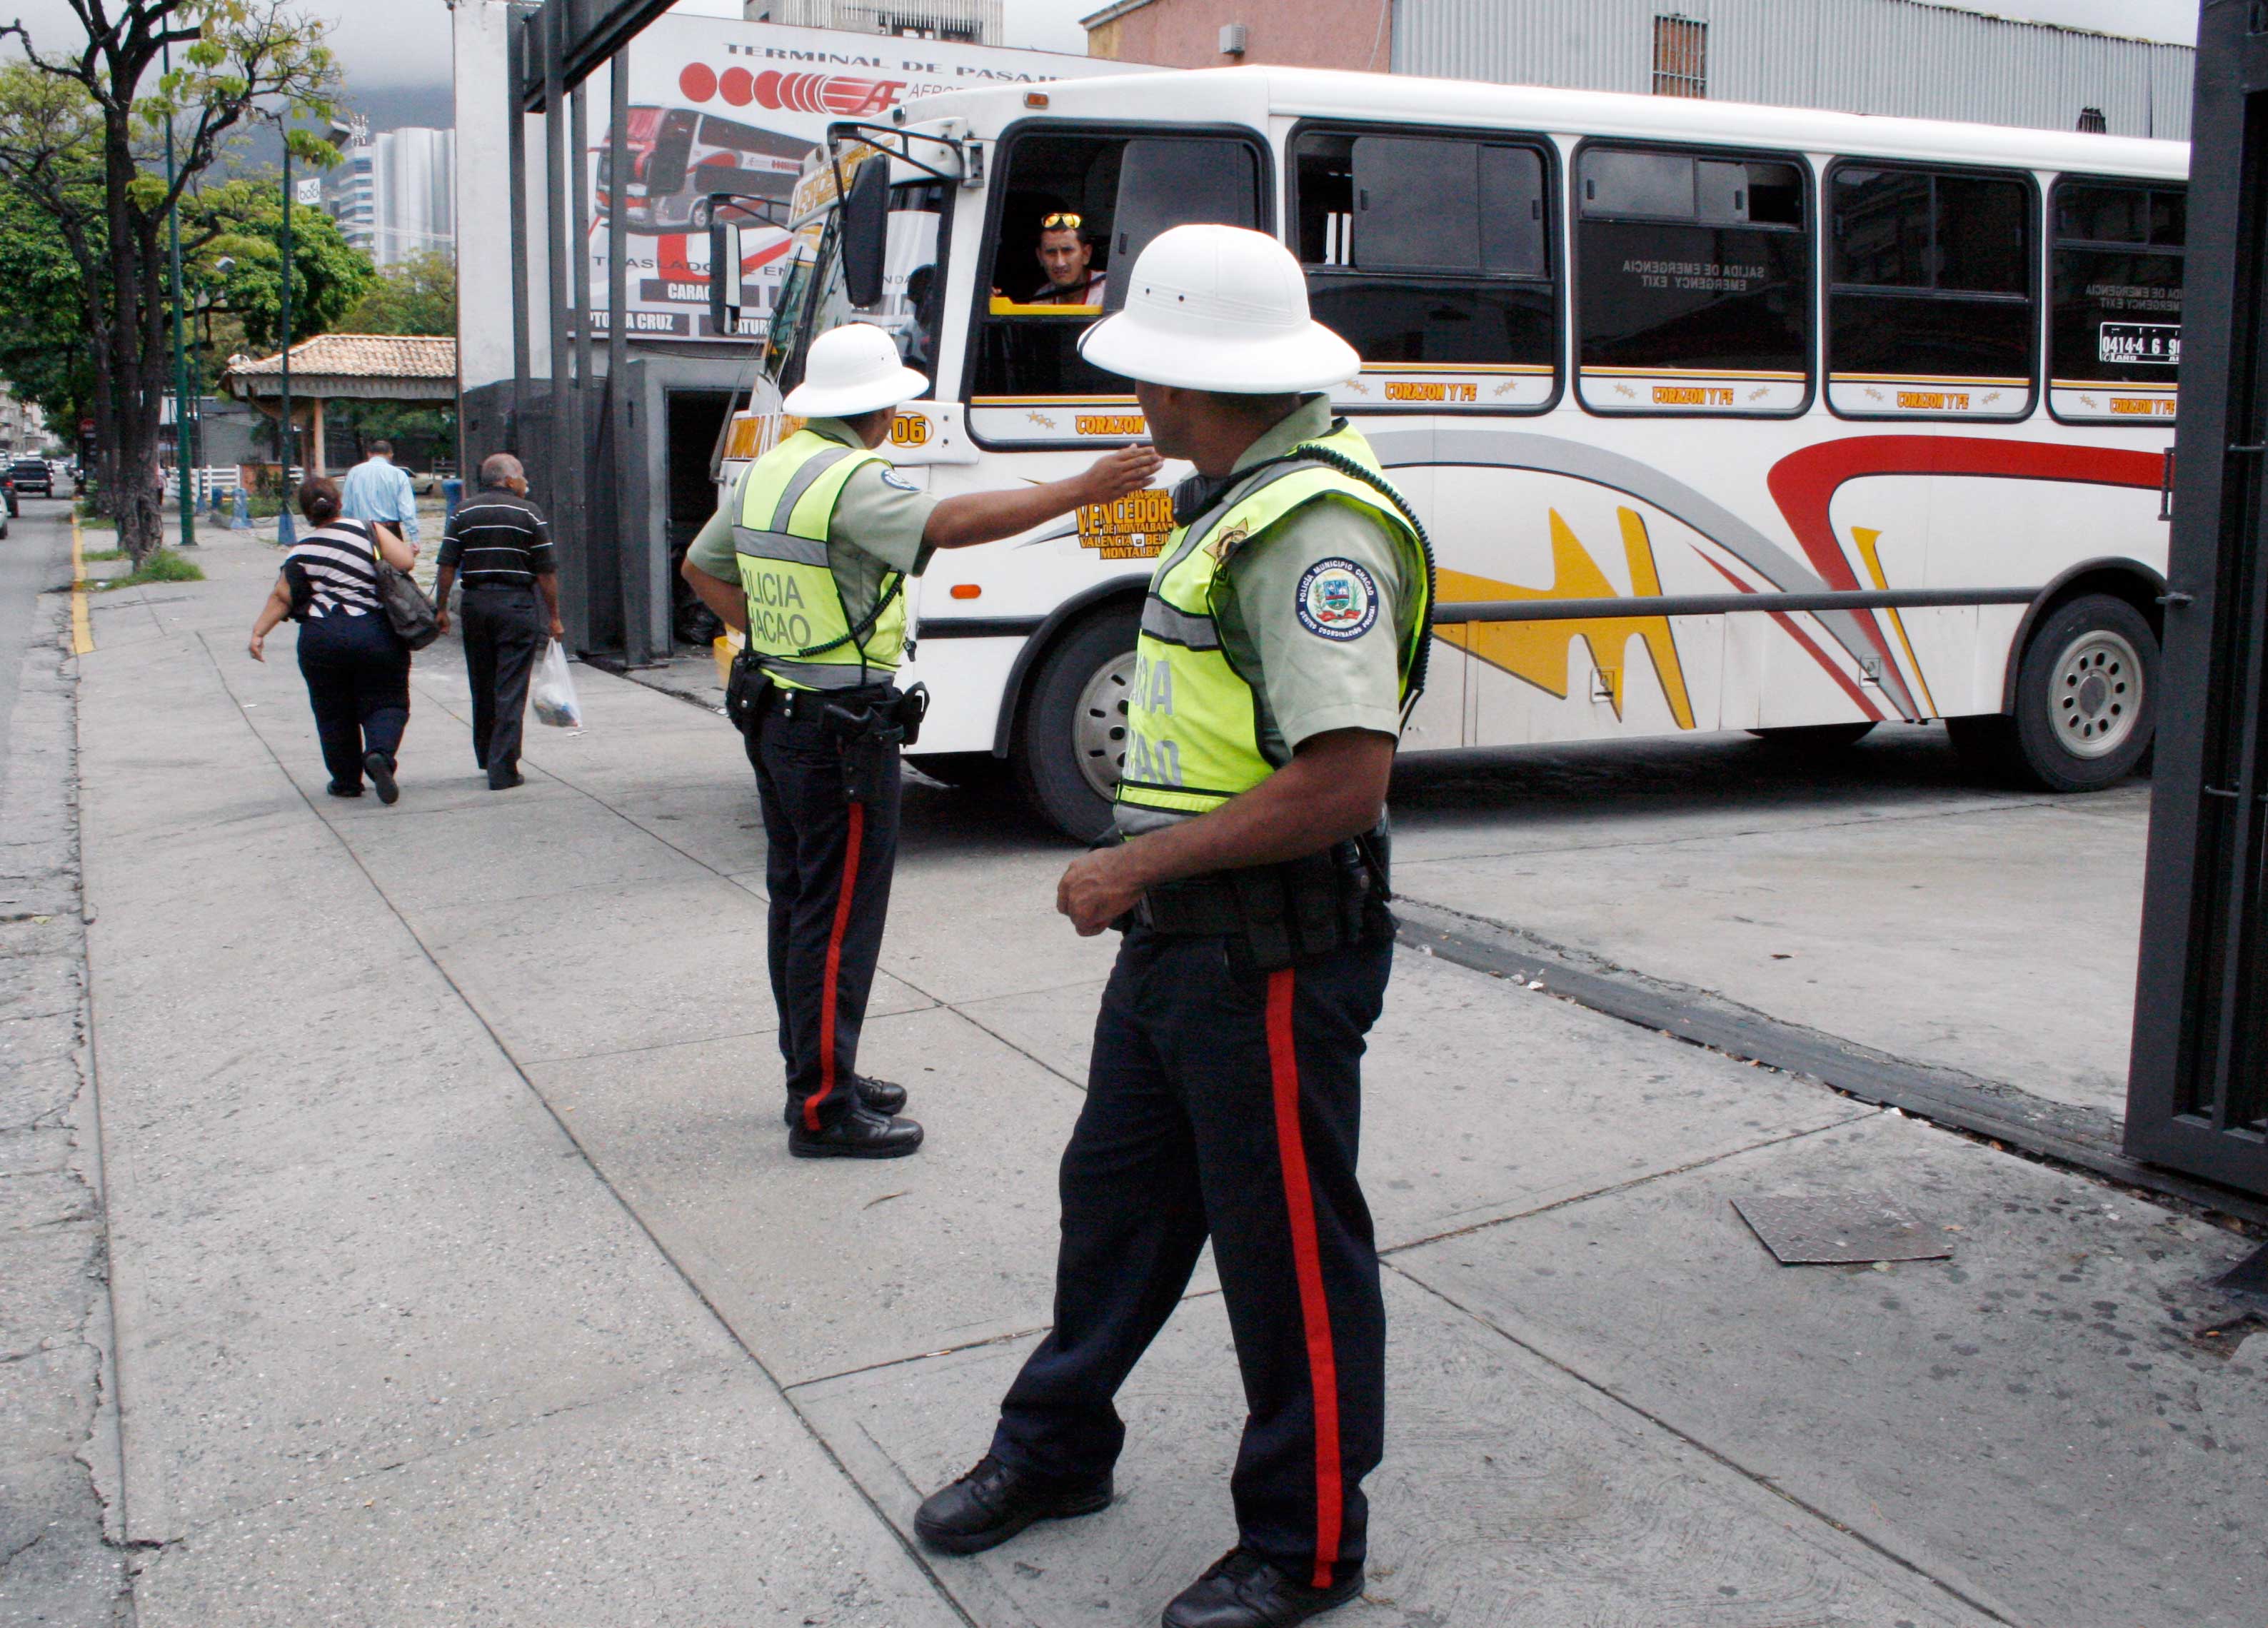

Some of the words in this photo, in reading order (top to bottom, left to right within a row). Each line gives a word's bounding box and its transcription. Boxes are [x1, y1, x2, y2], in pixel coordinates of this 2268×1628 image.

[723, 43, 890, 69] TERMINAL
[903, 61, 944, 74] DE
[637, 313, 673, 331] CRUZ
[1385, 381, 1446, 401] CORAZON
[1447, 383, 1459, 401] Y
[1459, 383, 1477, 401] FE
[1652, 386, 1706, 405] CORAZON
[1707, 388, 1718, 405] Y
[1718, 388, 1734, 405] FE
[1897, 391, 1945, 409] CORAZON
[1945, 393, 1956, 410] Y
[1955, 393, 1970, 410] FE
[2109, 398, 2153, 415] CORAZON
[891, 416, 926, 444] 06
[1075, 415, 1145, 435] CORAZON
[1075, 497, 1174, 536] VENCEDOR
[1103, 523, 1115, 534] DE
[1079, 534, 1134, 548] VALENCIA
[1100, 546, 1162, 560] MONTALBA
[1313, 561, 1353, 574] MUNICIPIO
[1355, 568, 1375, 596] CHACAO
[743, 568, 806, 609] OLICIA
